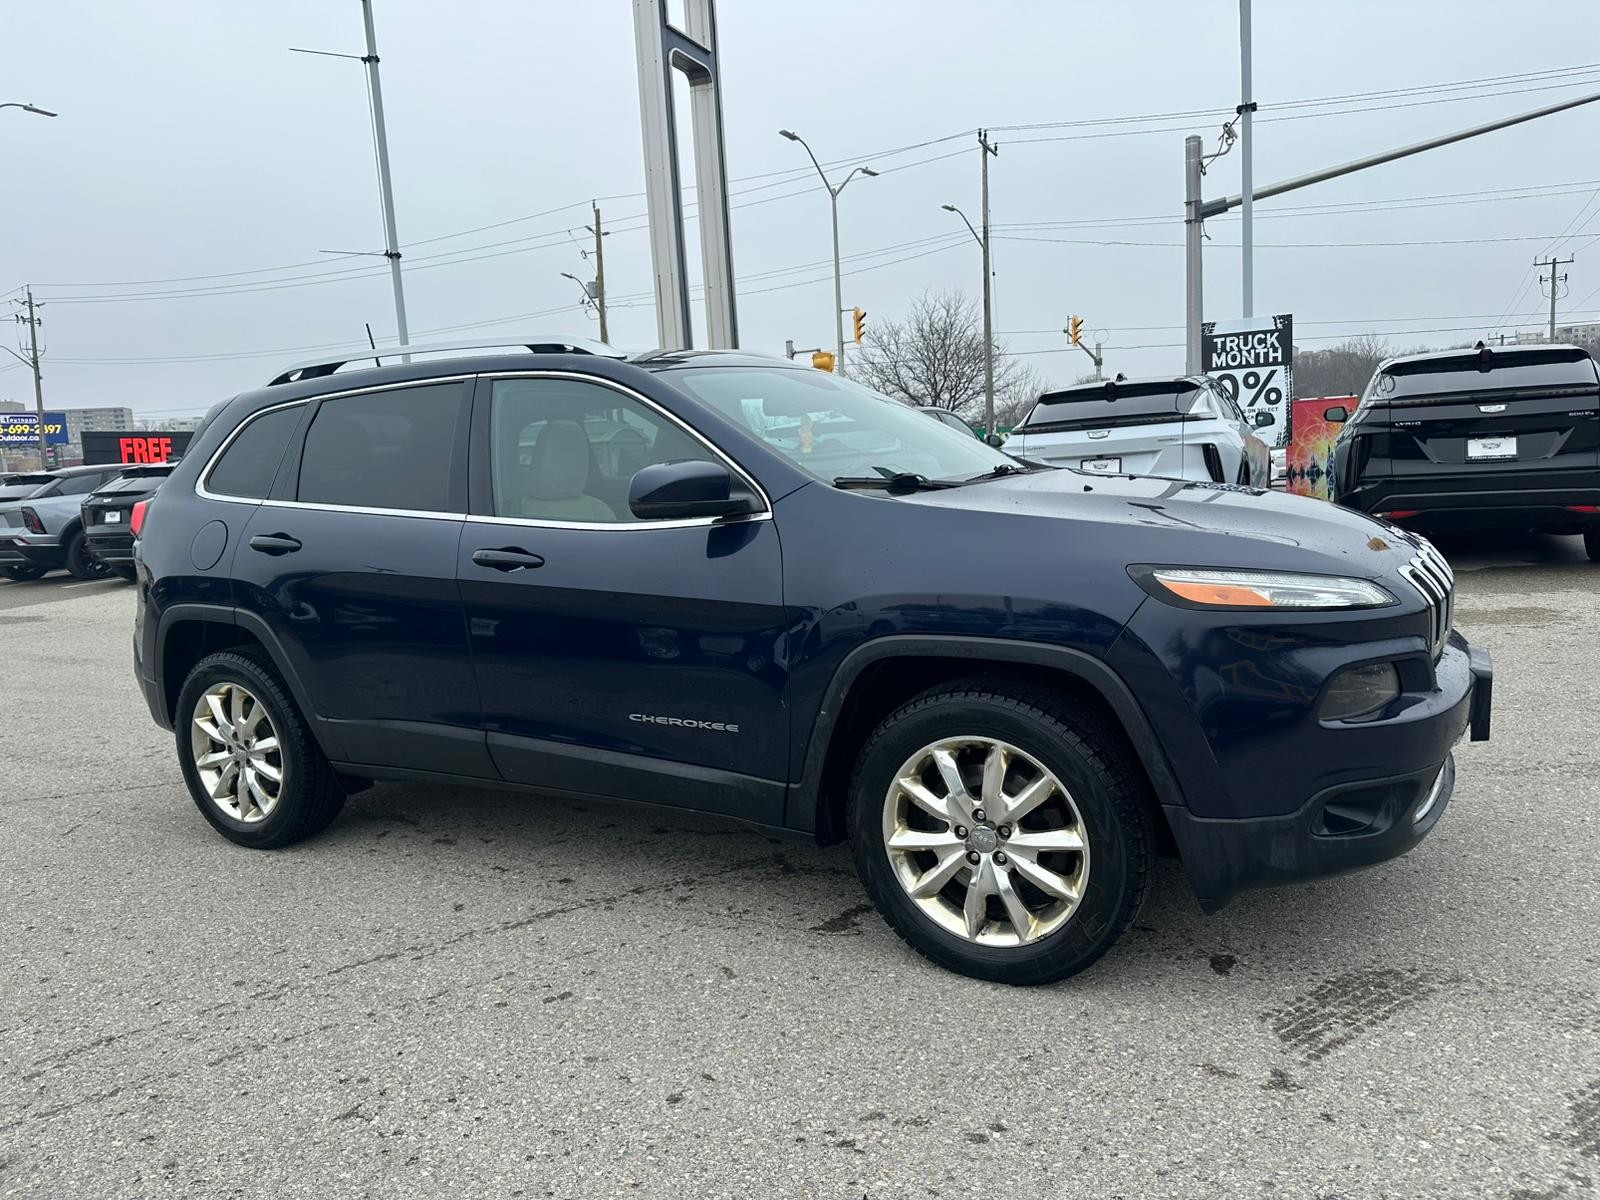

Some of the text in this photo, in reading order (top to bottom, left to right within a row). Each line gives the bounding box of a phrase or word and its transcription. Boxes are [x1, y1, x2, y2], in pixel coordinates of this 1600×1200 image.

[1213, 332, 1280, 353] TRUCK
[1212, 347, 1282, 368] MONTH
[120, 437, 171, 464] FREE
[628, 713, 740, 733] CHEROKEE
